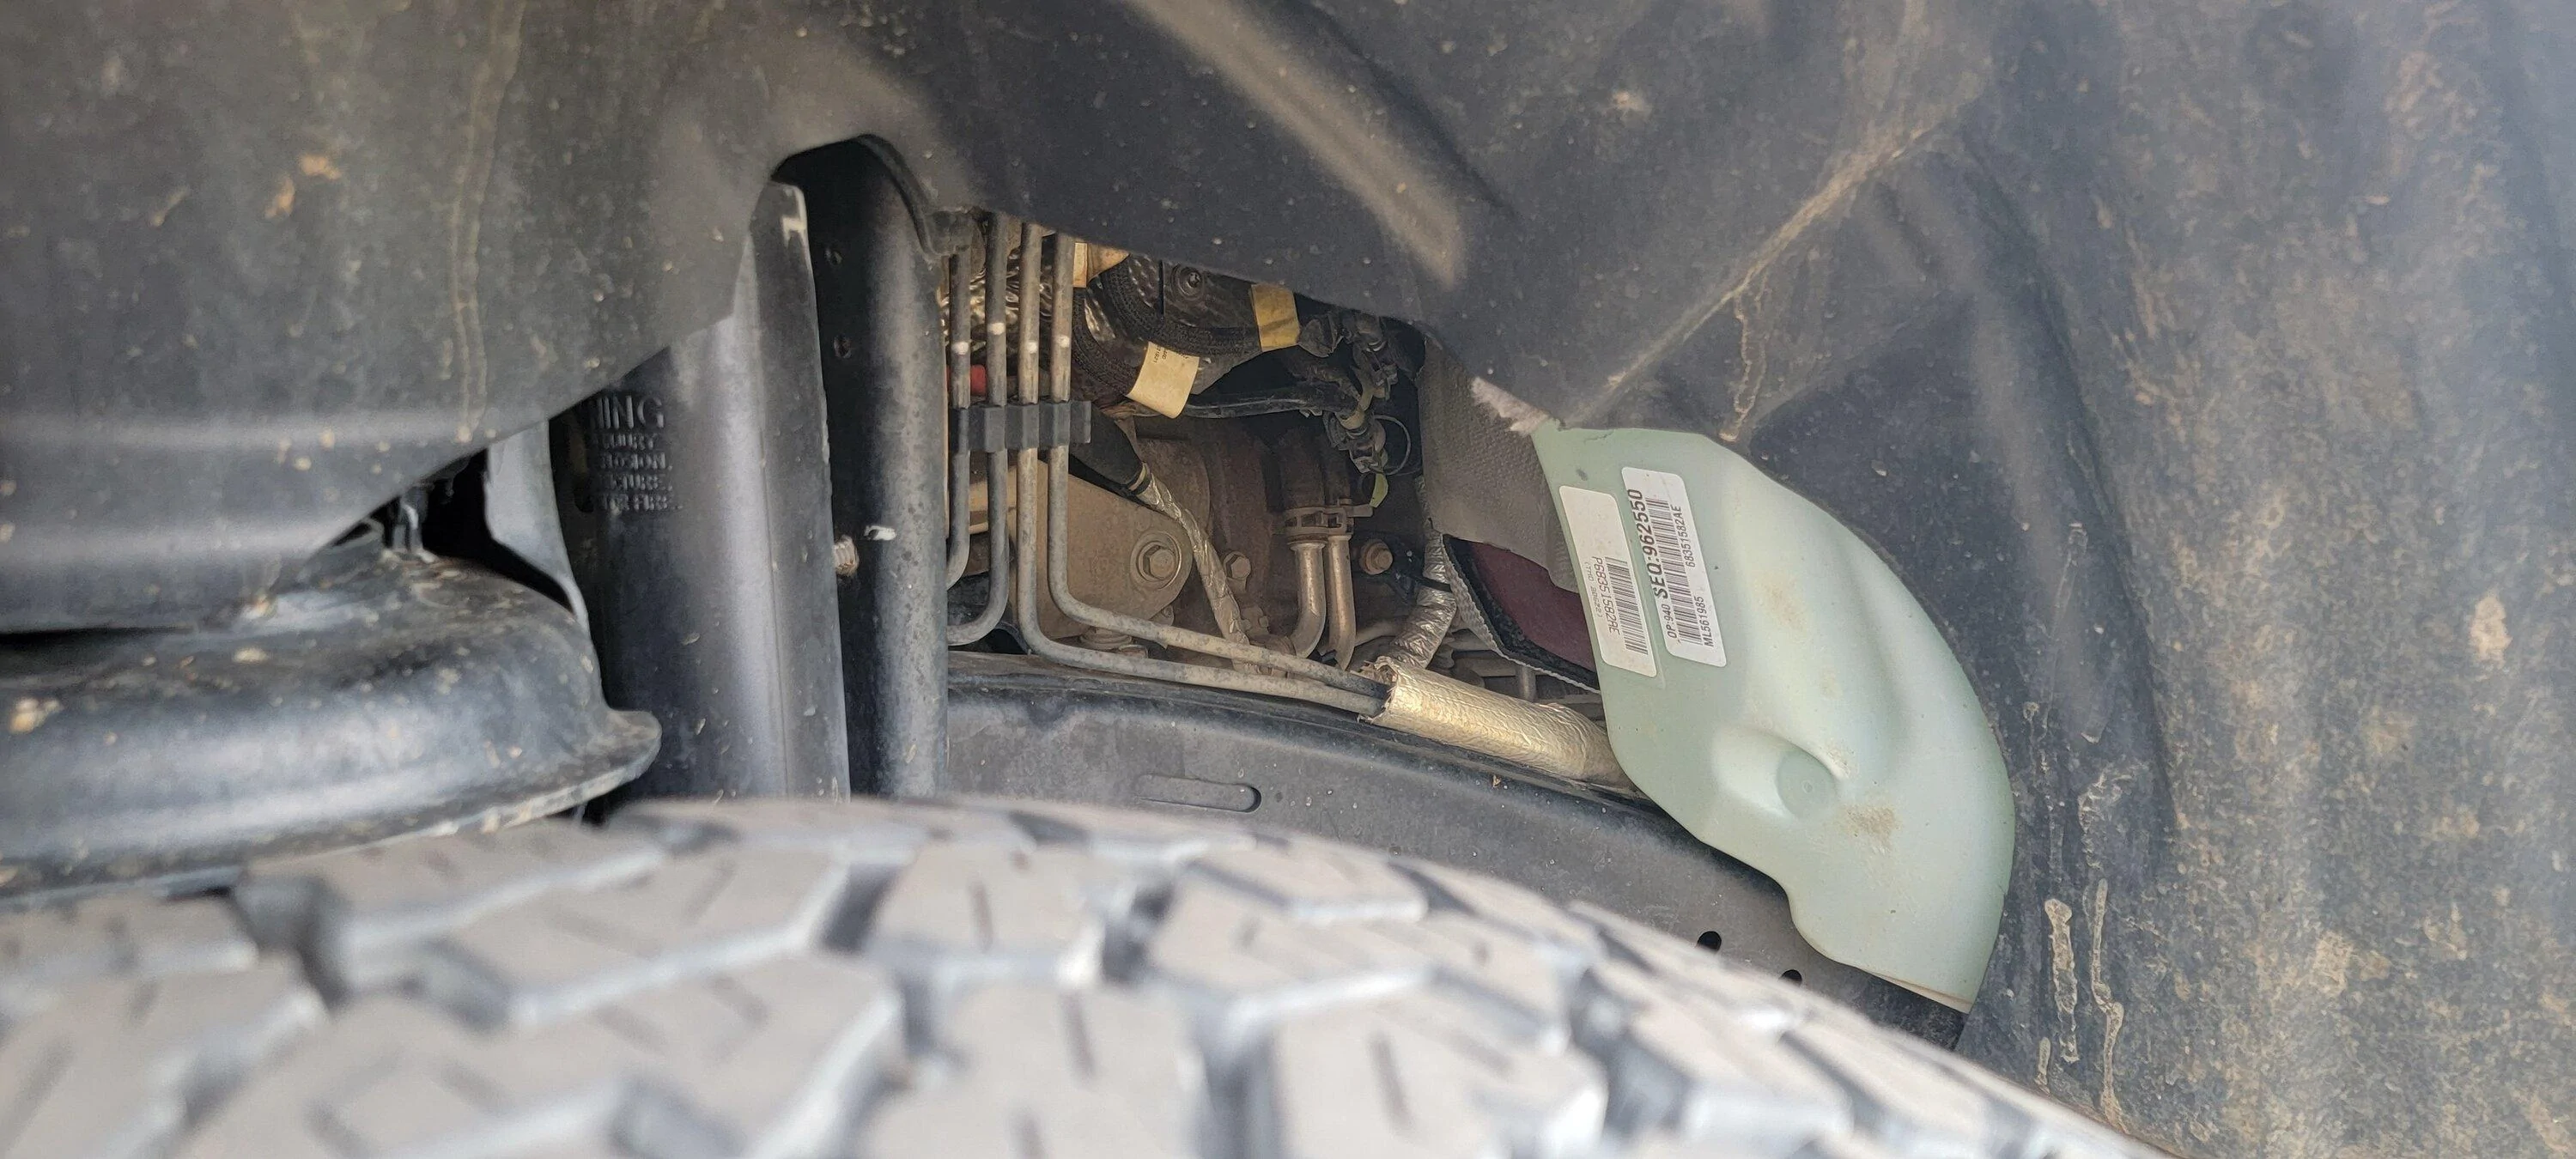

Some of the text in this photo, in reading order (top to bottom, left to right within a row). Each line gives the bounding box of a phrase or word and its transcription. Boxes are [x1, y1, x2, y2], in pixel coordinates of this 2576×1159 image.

[1627, 488, 1669, 599] SEQ:962550
[1670, 504, 1714, 647] ML561985 68351582AE
